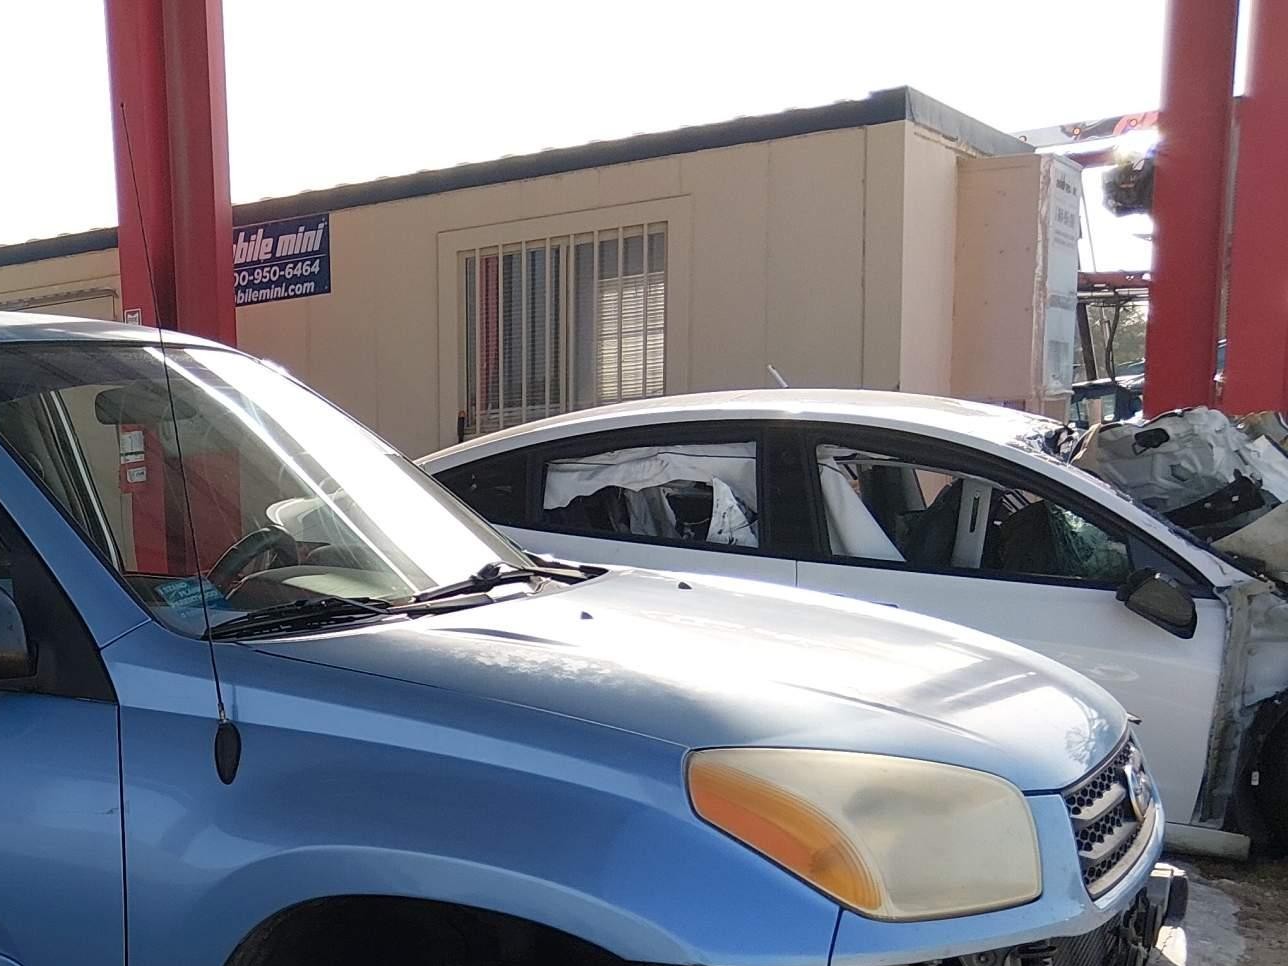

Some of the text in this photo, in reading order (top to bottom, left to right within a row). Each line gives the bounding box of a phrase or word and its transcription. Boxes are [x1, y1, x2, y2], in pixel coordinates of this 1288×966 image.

[233, 223, 324, 265] bile mini
[235, 281, 315, 304] bilemini.com
